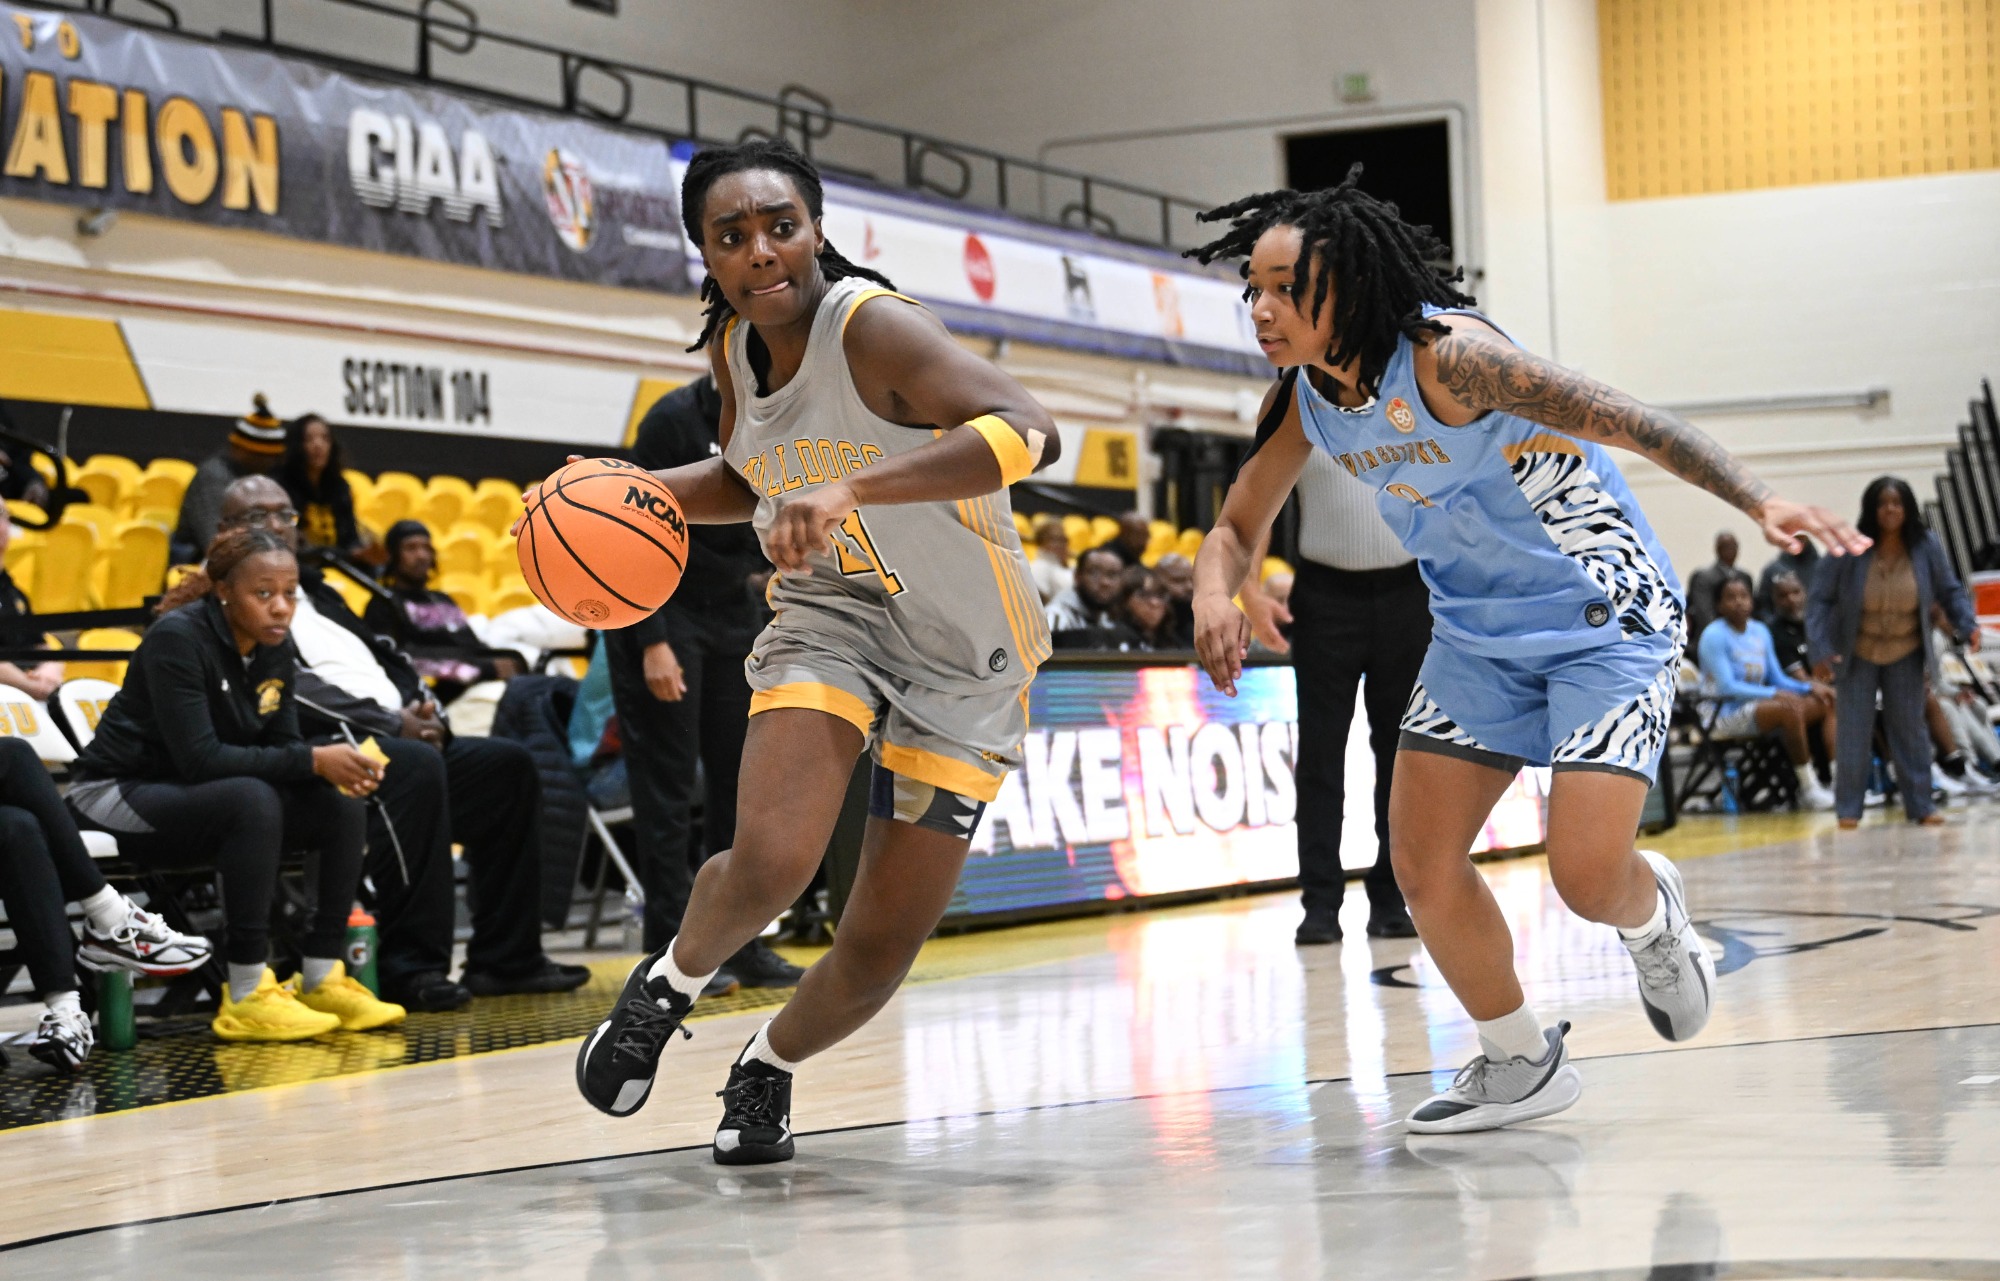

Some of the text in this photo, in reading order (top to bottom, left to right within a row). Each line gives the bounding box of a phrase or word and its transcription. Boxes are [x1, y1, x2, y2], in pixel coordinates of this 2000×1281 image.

[12, 13, 80, 59] TO
[0, 62, 279, 216] ATION
[348, 107, 503, 229] CIAA
[342, 357, 491, 426] SECTION 104
[623, 485, 686, 544] NCAA
[1136, 721, 1299, 840] NOIS
